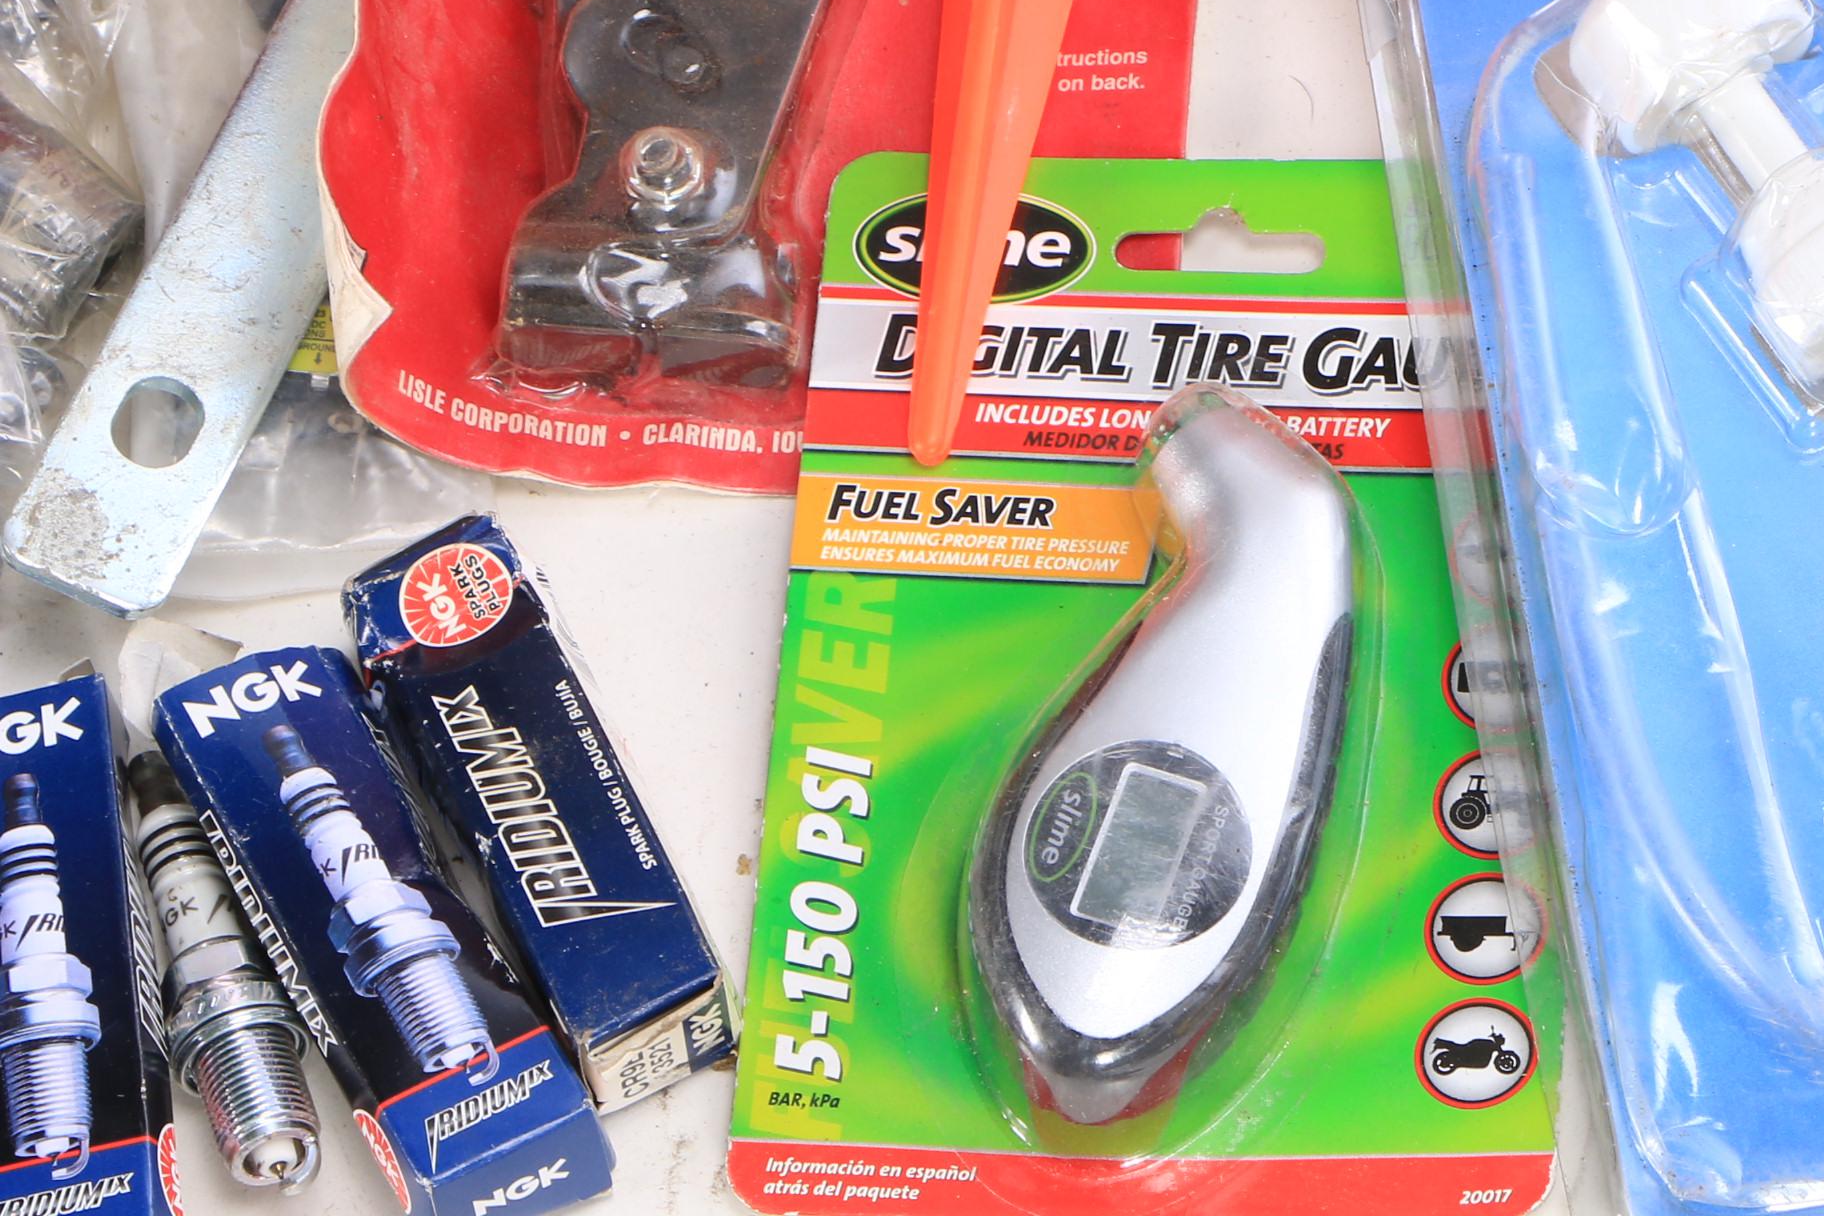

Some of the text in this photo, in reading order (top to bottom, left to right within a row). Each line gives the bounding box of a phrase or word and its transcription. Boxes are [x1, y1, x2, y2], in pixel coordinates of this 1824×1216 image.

[1056, 50, 1148, 67] tructions
[1058, 74, 1145, 92] on back.
[874, 313, 1128, 379] DGITAL
[1150, 321, 1289, 385] TIRE
[398, 369, 445, 415] LISLE
[451, 397, 607, 448] CORPORATION
[643, 423, 764, 455] CLARINDA,
[975, 402, 1391, 438] INCLUDES LON BATTERY
[1022, 430, 1120, 452] MEDIDOR
[826, 483, 1056, 529] FUEL SAVER
[819, 546, 1120, 573] ENSURES MAXIMUM FUEL ECONOMY
[821, 528, 1130, 556] MAINTAINING PROPER TIRE PRESSURE
[396, 572, 468, 639] NGK
[450, 562, 487, 620] SPARK
[464, 554, 502, 612] PLUGS
[0, 696, 85, 755] GK
[182, 660, 323, 739] NGK
[577, 727, 613, 780] BOUGIE
[606, 786, 635, 827] PLUG
[1041, 787, 1083, 866] slime
[625, 822, 658, 871] SPARK
[1172, 804, 1230, 931] SPORT GAUGE
[773, 745, 873, 1083] 5-150 PSI
[688, 1002, 726, 1057] NGK
[767, 1091, 841, 1109] BAR, kPa
[361, 1124, 400, 1179] NGK
[765, 1157, 977, 1183] Información en español
[472, 1158, 571, 1216] NGK
[763, 1180, 921, 1202] atrás del paquete
[1459, 1189, 1513, 1205] 20017
